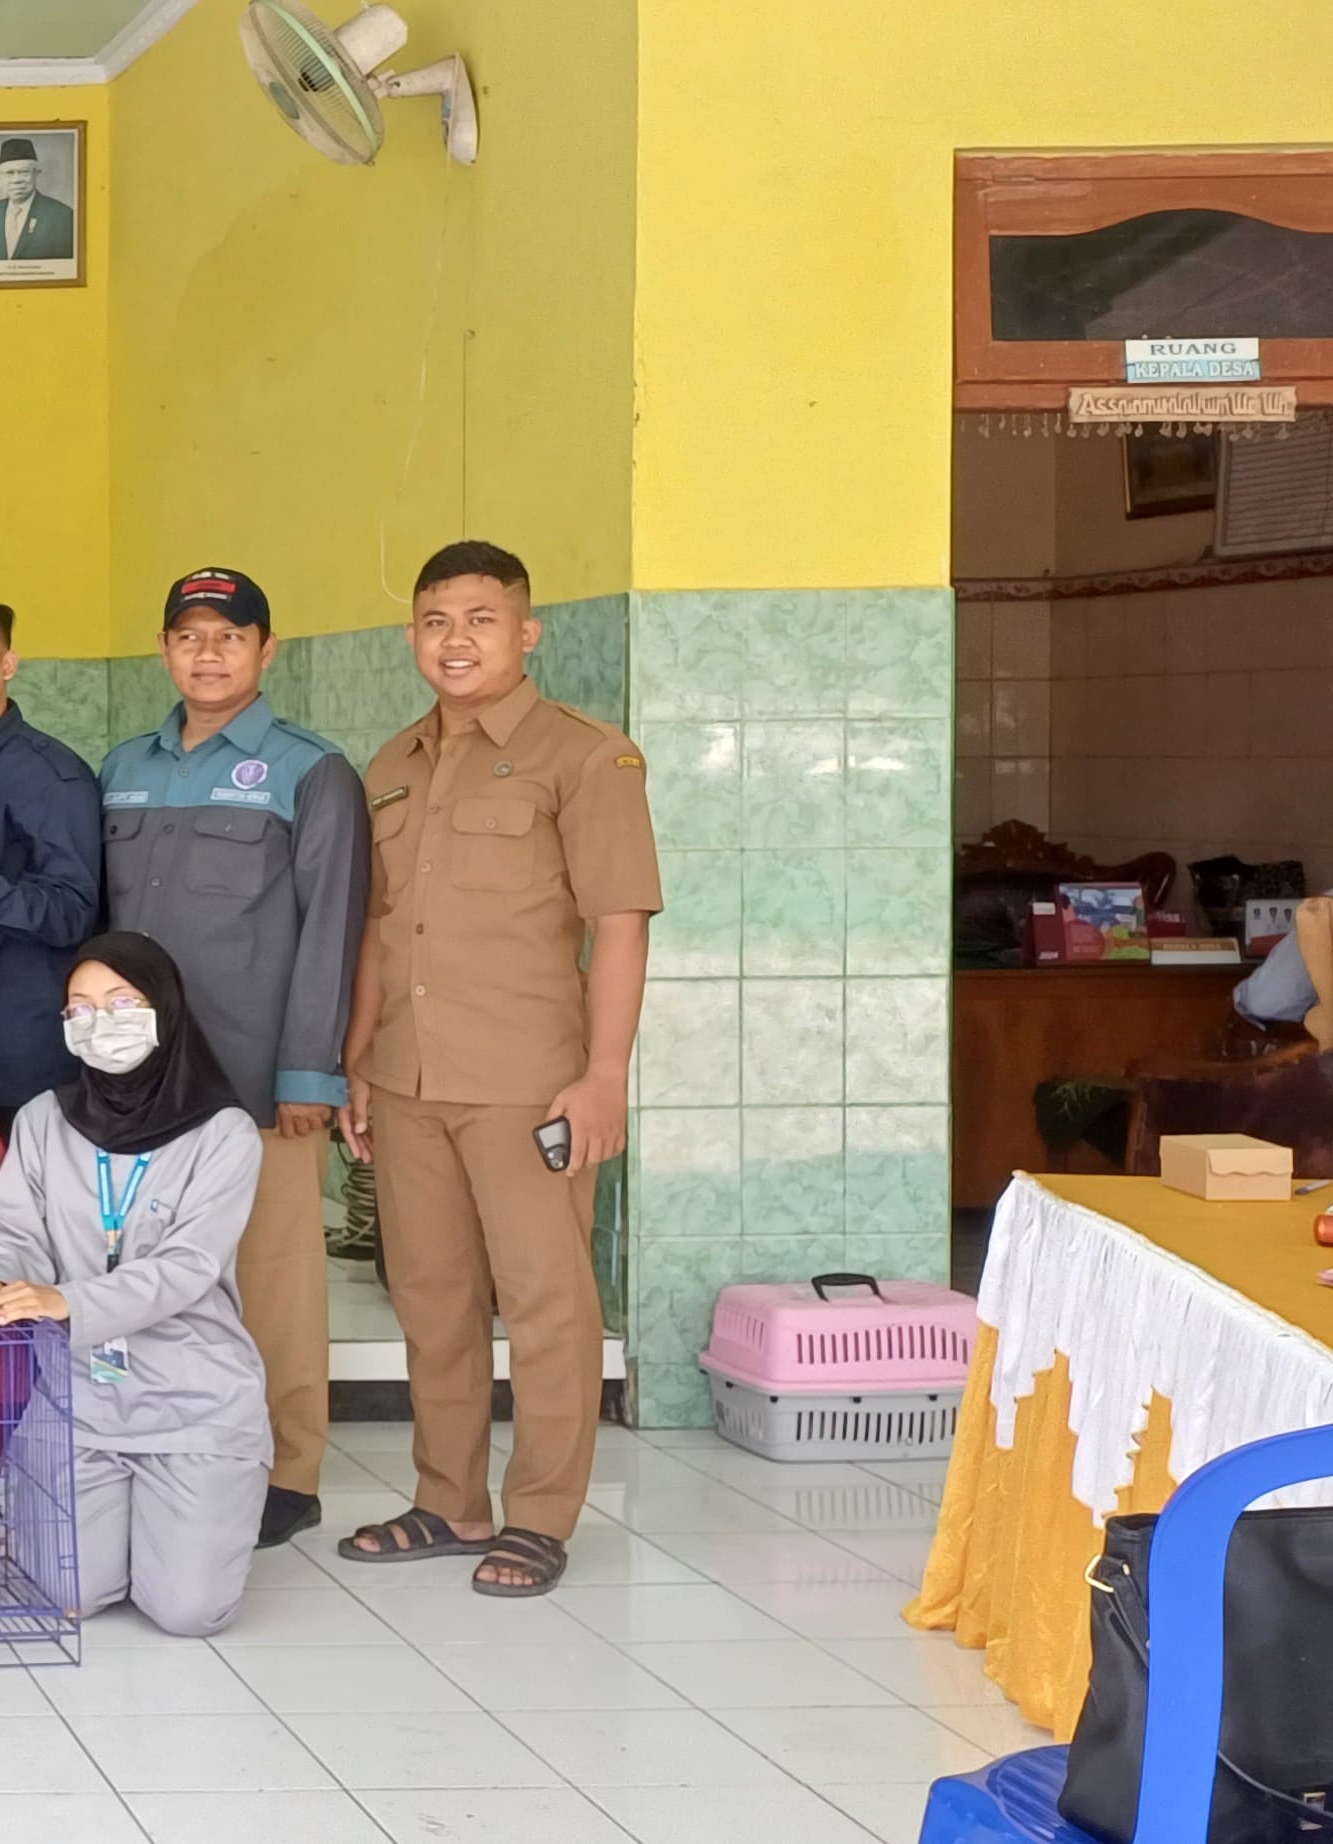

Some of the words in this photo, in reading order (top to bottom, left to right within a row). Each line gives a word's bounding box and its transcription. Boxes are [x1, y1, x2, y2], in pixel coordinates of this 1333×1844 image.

[1150, 343, 1237, 355] RUANG
[1135, 362, 1203, 378] KEPALA
[1209, 361, 1254, 377] DESA
